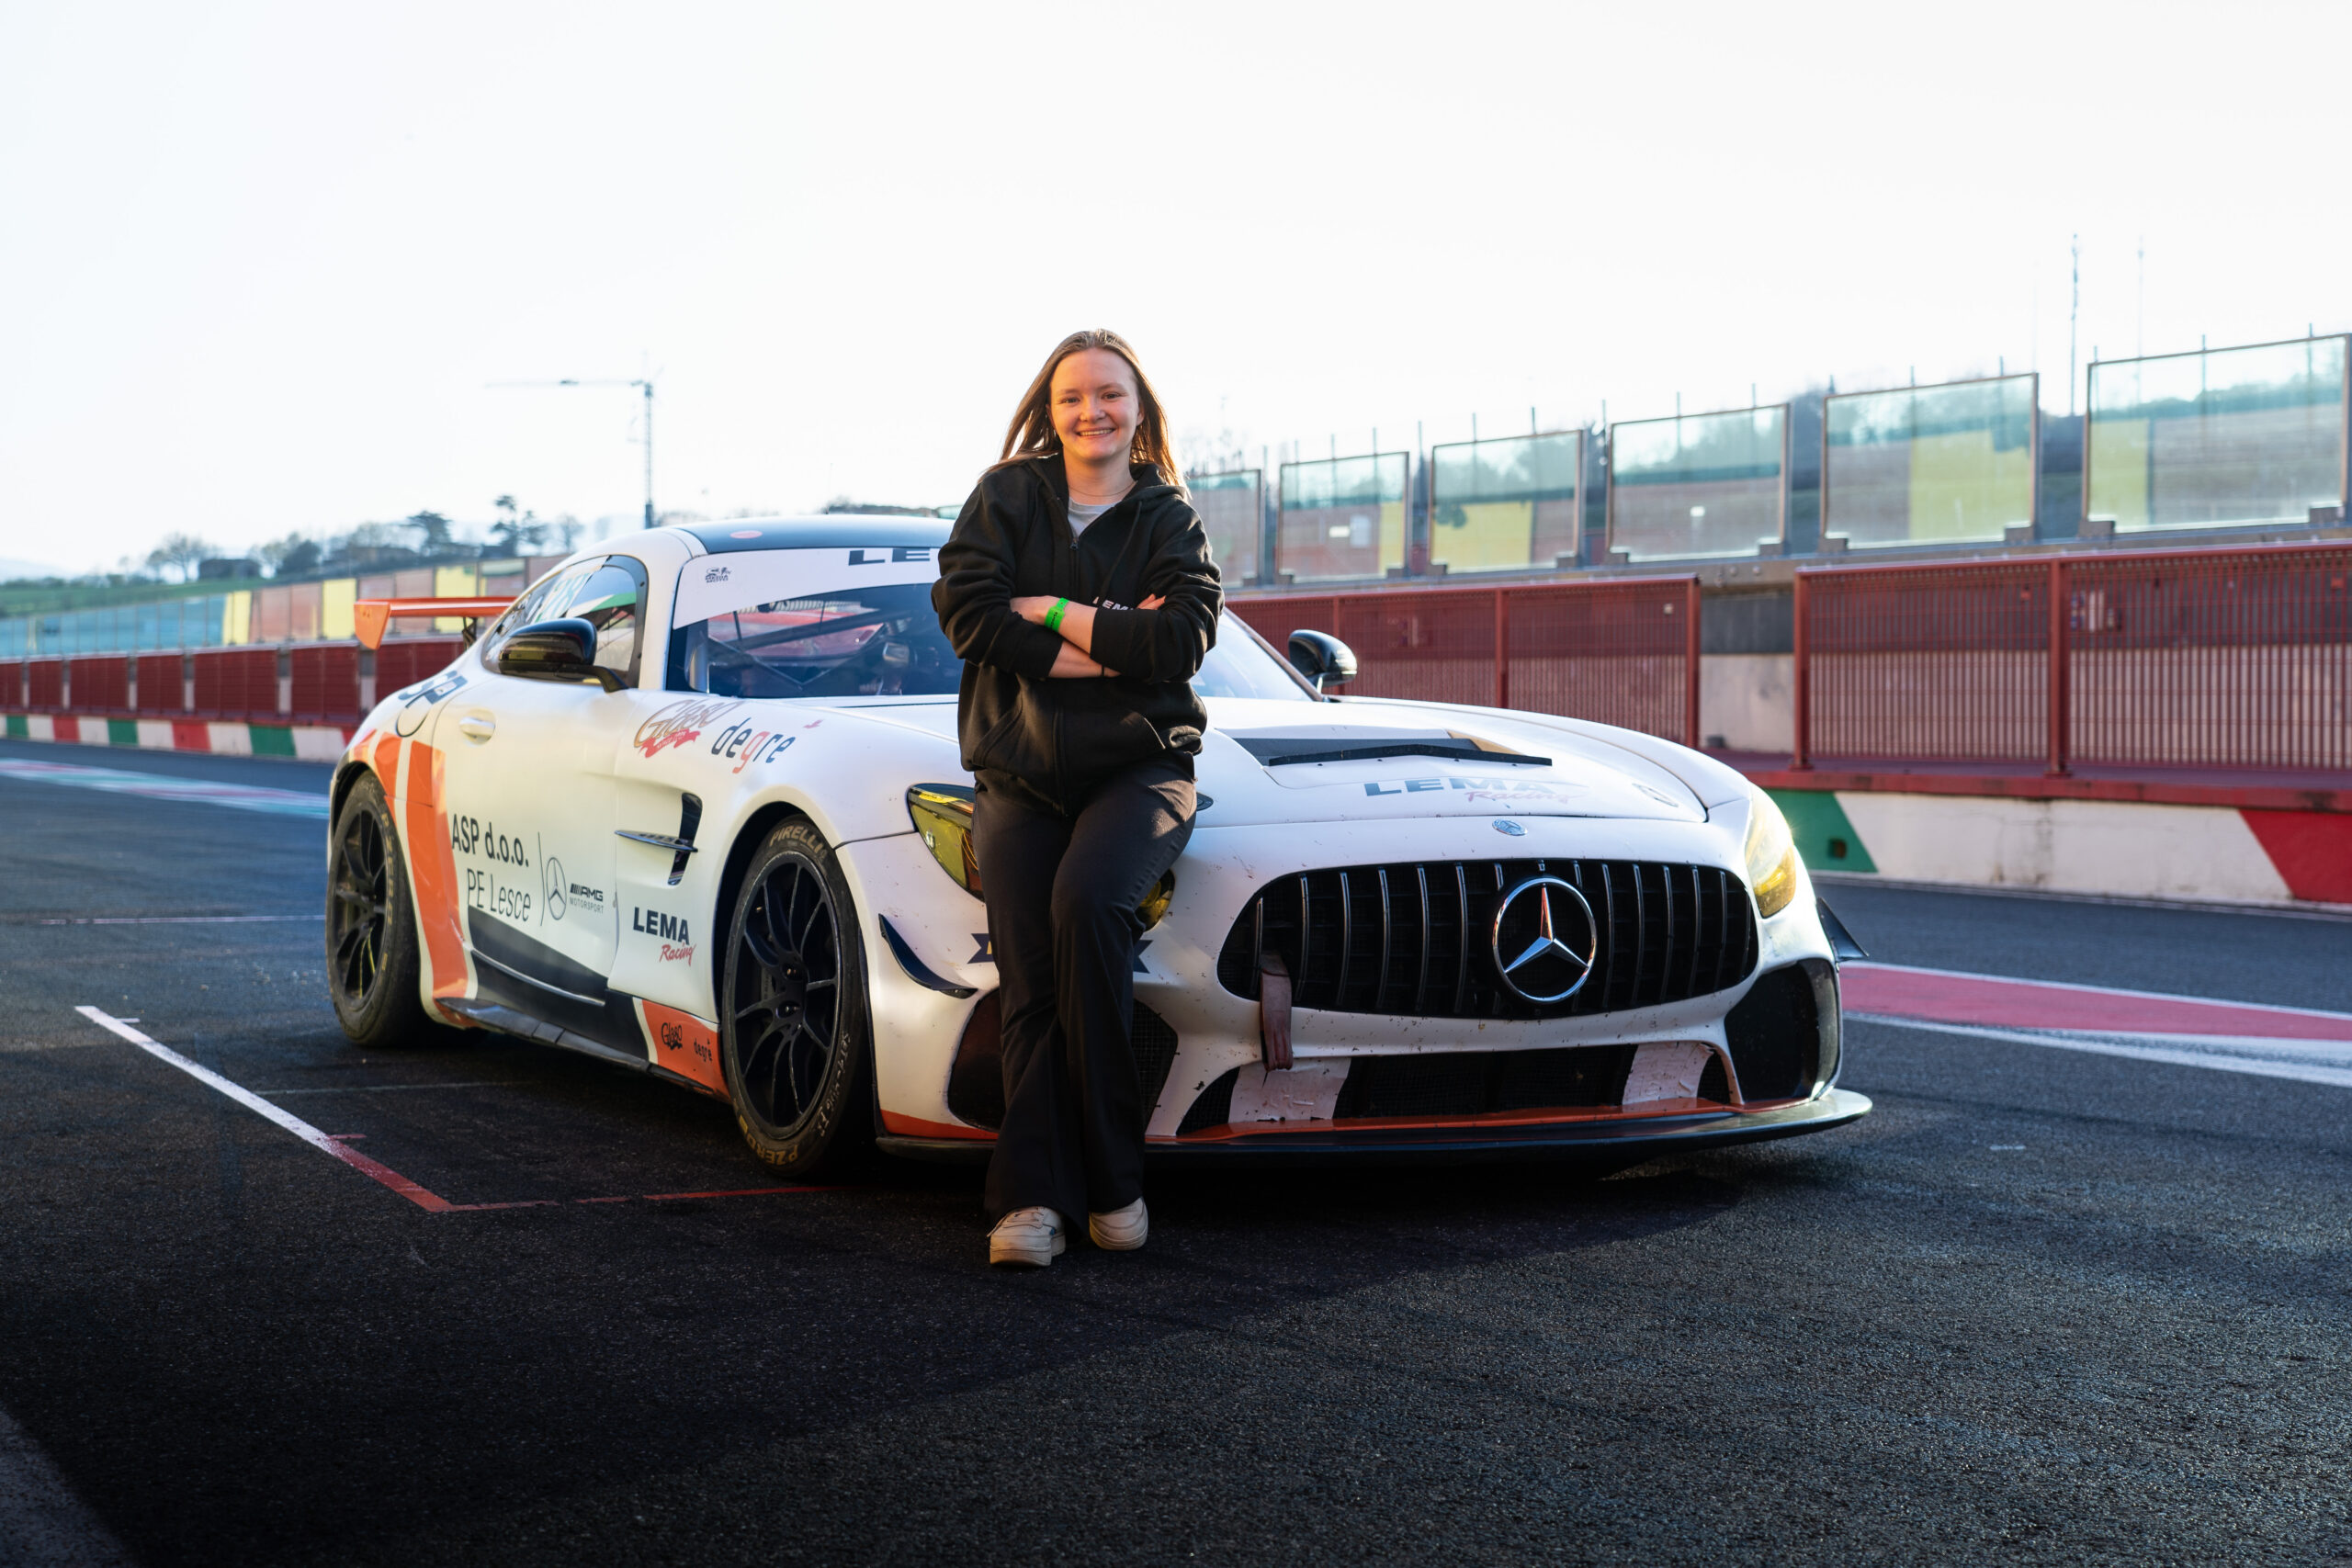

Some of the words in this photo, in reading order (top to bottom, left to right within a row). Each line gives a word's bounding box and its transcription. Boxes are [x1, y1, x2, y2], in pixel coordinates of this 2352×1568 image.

[848, 547, 930, 566] LE
[1092, 596, 1135, 610] EM
[1363, 777, 1555, 796] LEMA
[451, 814, 479, 855] ASP
[485, 821, 529, 867] d.o.o.
[770, 825, 823, 854] PIRELLI
[467, 868, 485, 908] PE
[490, 874, 531, 921] Lesce
[581, 886, 604, 902] AMG
[570, 897, 605, 914] MOTORSPORT
[633, 907, 690, 945] LEMA
[660, 942, 696, 966] Racing
